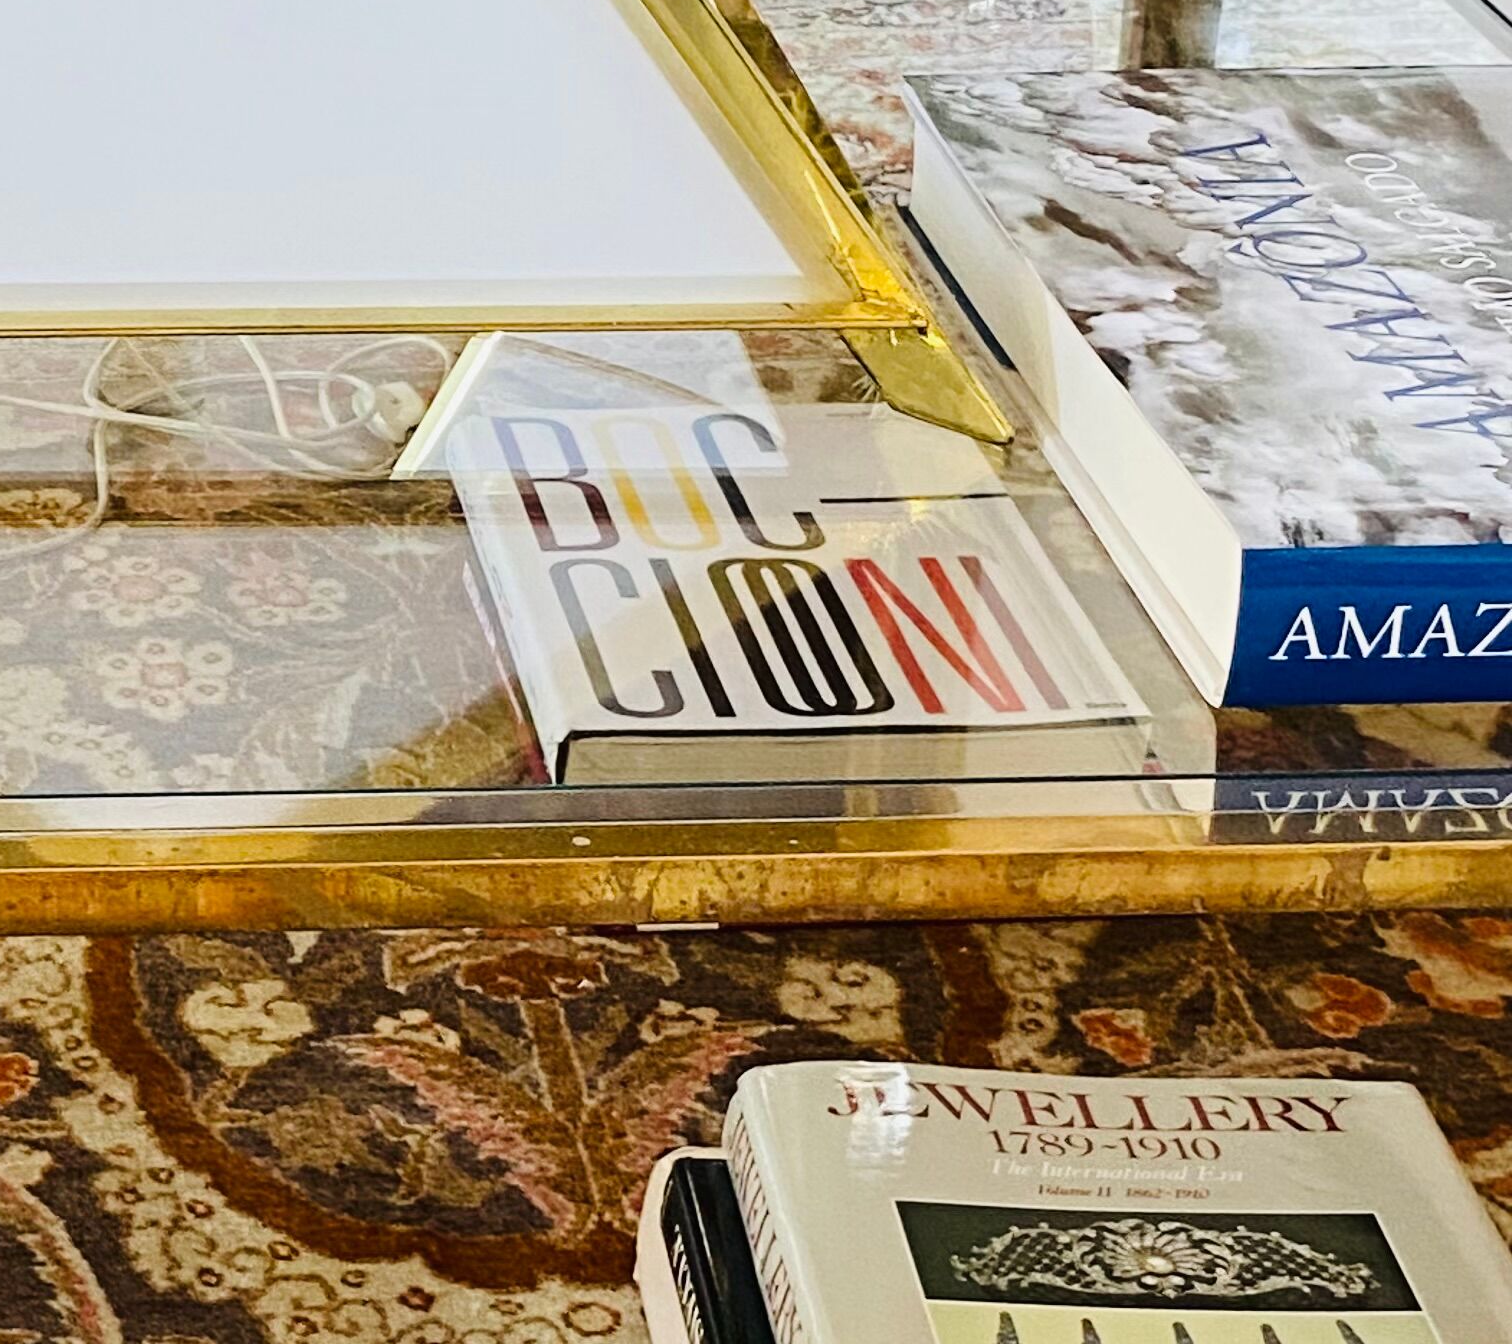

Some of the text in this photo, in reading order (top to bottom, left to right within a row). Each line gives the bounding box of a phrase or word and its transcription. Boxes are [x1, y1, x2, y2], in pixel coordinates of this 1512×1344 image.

[1344, 151, 1497, 270] SALGADO
[1178, 132, 1512, 442] AMAZÔNIA
[1268, 602, 1512, 661] AMAZ
[991, 1157, 1031, 1177] The
[1040, 1160, 1189, 1182] International
